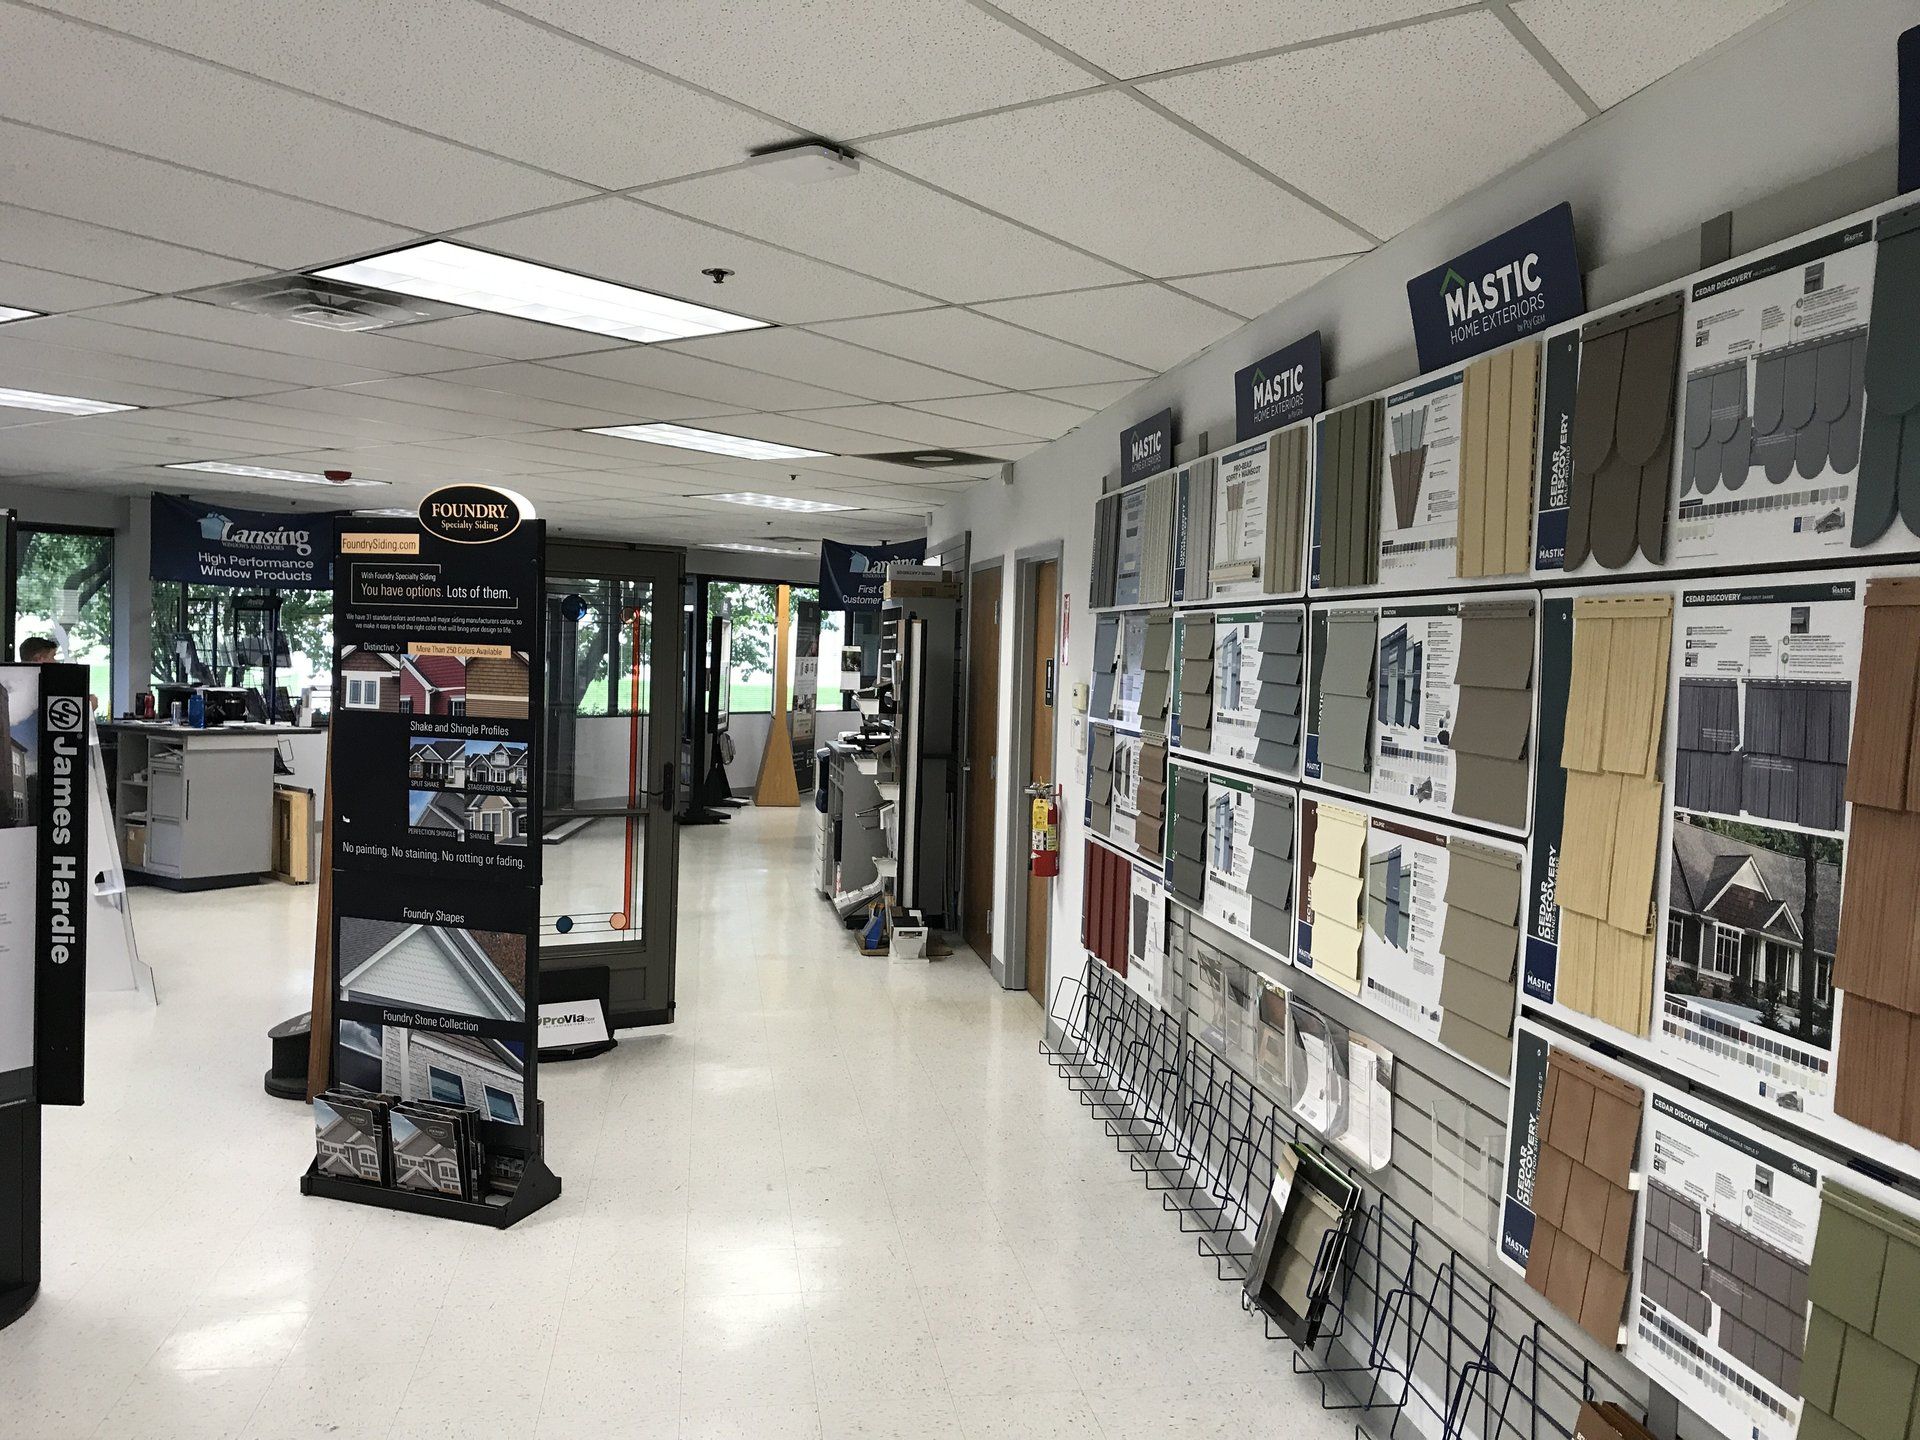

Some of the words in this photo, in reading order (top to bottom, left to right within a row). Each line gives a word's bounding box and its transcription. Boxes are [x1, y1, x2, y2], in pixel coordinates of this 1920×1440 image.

[1445, 253, 1542, 326] MASTIC
[1695, 284, 1716, 297] CEDAR
[1716, 270, 1752, 290] DISCOVERY
[1450, 320, 1480, 344] HOME
[1482, 293, 1545, 332] EXTERIORS
[1254, 364, 1304, 410] MASTIC
[1254, 408, 1270, 423] HOME
[1271, 393, 1304, 416] EXTERIORS
[1132, 430, 1162, 462] MASTIC
[1556, 413, 1568, 506] DISCOVERY
[1550, 450, 1560, 507] CEDAR
[432, 503, 508, 519] FOUNDRY
[441, 520, 472, 530] Specialty
[475, 521, 498, 532] Siding
[222, 522, 312, 556] Lansing
[342, 537, 416, 552] FoundrySiding.com
[199, 552, 226, 566] High
[230, 556, 314, 569] Performance
[1539, 548, 1564, 560] MASTIC
[200, 565, 250, 578] Window
[255, 570, 312, 581] Products
[361, 572, 373, 580] With
[374, 572, 394, 580] Foundry
[395, 573, 418, 581] Specialty
[420, 573, 436, 582] Siding
[361, 583, 378, 596] You
[381, 585, 403, 597] have
[406, 585, 444, 600] options.
[447, 585, 467, 599] Lots
[470, 586, 480, 599] of
[483, 587, 511, 600] them.
[858, 585, 876, 594] First
[1685, 594, 1705, 602] CEDAR
[1706, 593, 1741, 602] DISCOVERY
[842, 594, 882, 604] Customer
[364, 643, 394, 652] Distinctive
[446, 646, 457, 654] 250
[476, 647, 502, 655] Available
[410, 721, 432, 732] Shake
[435, 722, 449, 732] and
[450, 723, 479, 735] Shingle
[481, 724, 509, 736] Profiles
[52, 736, 78, 845] James
[411, 780, 423, 788] SPLIT
[468, 784, 494, 792] STAGGERED
[408, 828, 435, 836] PERFECTION
[436, 830, 456, 838] SHINGLE
[342, 842, 354, 853] No
[356, 844, 389, 858] painting.
[392, 846, 404, 857] No
[405, 848, 440, 862] staining.
[442, 850, 454, 862] No
[456, 853, 483, 866] rotting
[496, 856, 525, 868] fading.
[1544, 844, 1557, 939] DISCOVERY
[51, 856, 76, 964] Hardie
[403, 908, 434, 922] Foundry
[436, 911, 464, 924] Shapes
[1538, 881, 1548, 937] CEDAR
[1528, 974, 1552, 992] MASTIC
[383, 1010, 413, 1024] Foundry
[414, 1013, 438, 1027] Stone
[440, 1016, 479, 1032] Collection
[543, 1014, 584, 1026] ProVia
[1654, 1100, 1674, 1114] CEDAR
[1674, 1108, 1708, 1130] DISCOVERY
[1523, 1113, 1537, 1206] DISCOVERY
[1516, 1144, 1528, 1200] CEDAR
[1505, 1235, 1528, 1259] MASTIC
